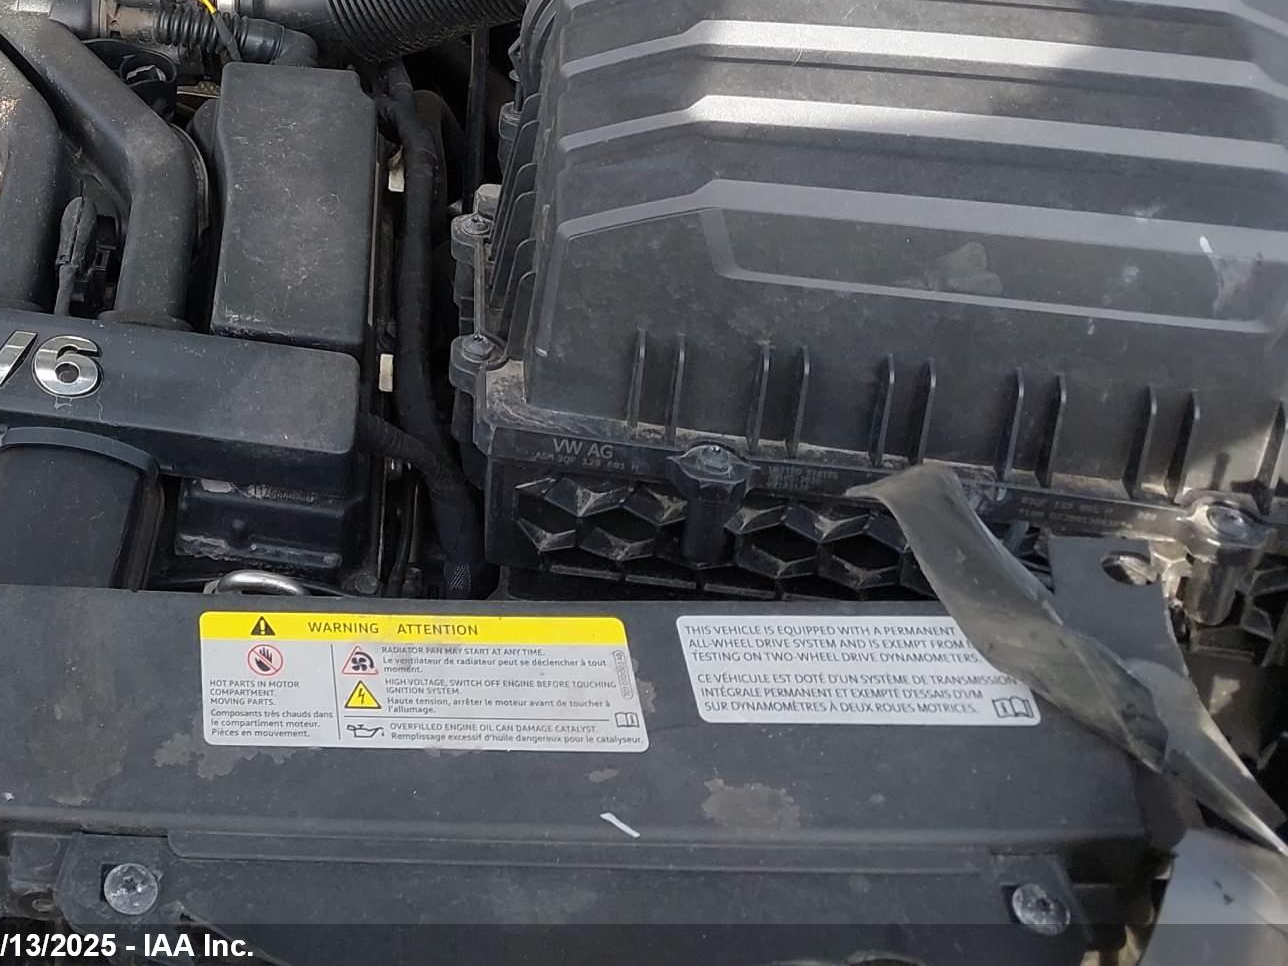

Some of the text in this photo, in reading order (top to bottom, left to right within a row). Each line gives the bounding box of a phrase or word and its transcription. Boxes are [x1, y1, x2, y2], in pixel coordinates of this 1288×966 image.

[552, 437, 613, 459] VW AG
[307, 621, 380, 635] WARNING
[396, 623, 479, 636] ATTENTION
[684, 625, 713, 636] THIS
[712, 625, 762, 636] VEHICLE
[763, 625, 776, 635] IS
[776, 625, 837, 637] EQUIPPED
[836, 625, 871, 636] WITH
[883, 625, 956, 636] PERMANENT
[688, 638, 754, 649] ALL-WHEEL
[754, 638, 791, 649] DRIVE
[792, 638, 838, 649] SYSTEM
[839, 639, 867, 649] AND
[868, 639, 881, 649] IS
[881, 639, 927, 649] EXEMPT
[929, 639, 965, 650] FROM
[381, 646, 545, 657] RADIATOR FAN MAY START AT ANY TIME.
[692, 651, 742, 663] TESTING
[742, 651, 763, 662] ON
[764, 651, 840, 663] TWO-WHEEL
[840, 652, 876, 663] DRIVE
[382, 656, 394, 665] Le
[394, 657, 442, 667] ventilateur
[443, 657, 455, 666] de
[456, 657, 496, 666] radiateur
[497, 659, 519, 668] peut
[519, 659, 531, 667] se
[531, 658, 579, 667] déclencher
[587, 659, 608, 668] tout
[209, 679, 228, 688] HOT
[228, 679, 256, 688] PARTS
[268, 680, 300, 689] MOTOR
[384, 678, 618, 690] HIGH VOLTAGE, SWITCH OFF ENGINE BEFORE TOUCHING
[697, 673, 713, 684] CE
[712, 672, 771, 684] VÉHICULE
[772, 673, 792, 684] EST
[793, 672, 824, 685] DOTÉ
[827, 673, 860, 685] D'UN
[859, 673, 909, 685] SYSTÈME
[911, 674, 927, 686] DE
[385, 686, 425, 695] IGNITION
[700, 685, 760, 698] INTÉGRALE
[763, 687, 833, 699] PERMANENT
[834, 688, 849, 699] ET
[849, 687, 899, 699] EXEMPTÉ
[901, 688, 953, 699] D'ESSAIS
[209, 697, 277, 707] MOVING PARTS.
[386, 696, 415, 705] Haute
[415, 698, 452, 708] tension,
[452, 697, 483, 707] arrêter
[494, 699, 528, 708] moteur
[529, 700, 555, 708] avant
[555, 699, 568, 708] de
[568, 699, 604, 708] toucher
[210, 708, 334, 719] Composants très chauds dans
[387, 705, 437, 716] l'allumage.
[220, 719, 284, 729] compartiment
[285, 720, 322, 729] moteur.
[389, 722, 444, 732] OVERFILLED
[444, 723, 477, 733] ENGINE
[479, 723, 493, 733] OIL
[495, 723, 515, 733] CAN
[515, 724, 552, 733] DAMAGE
